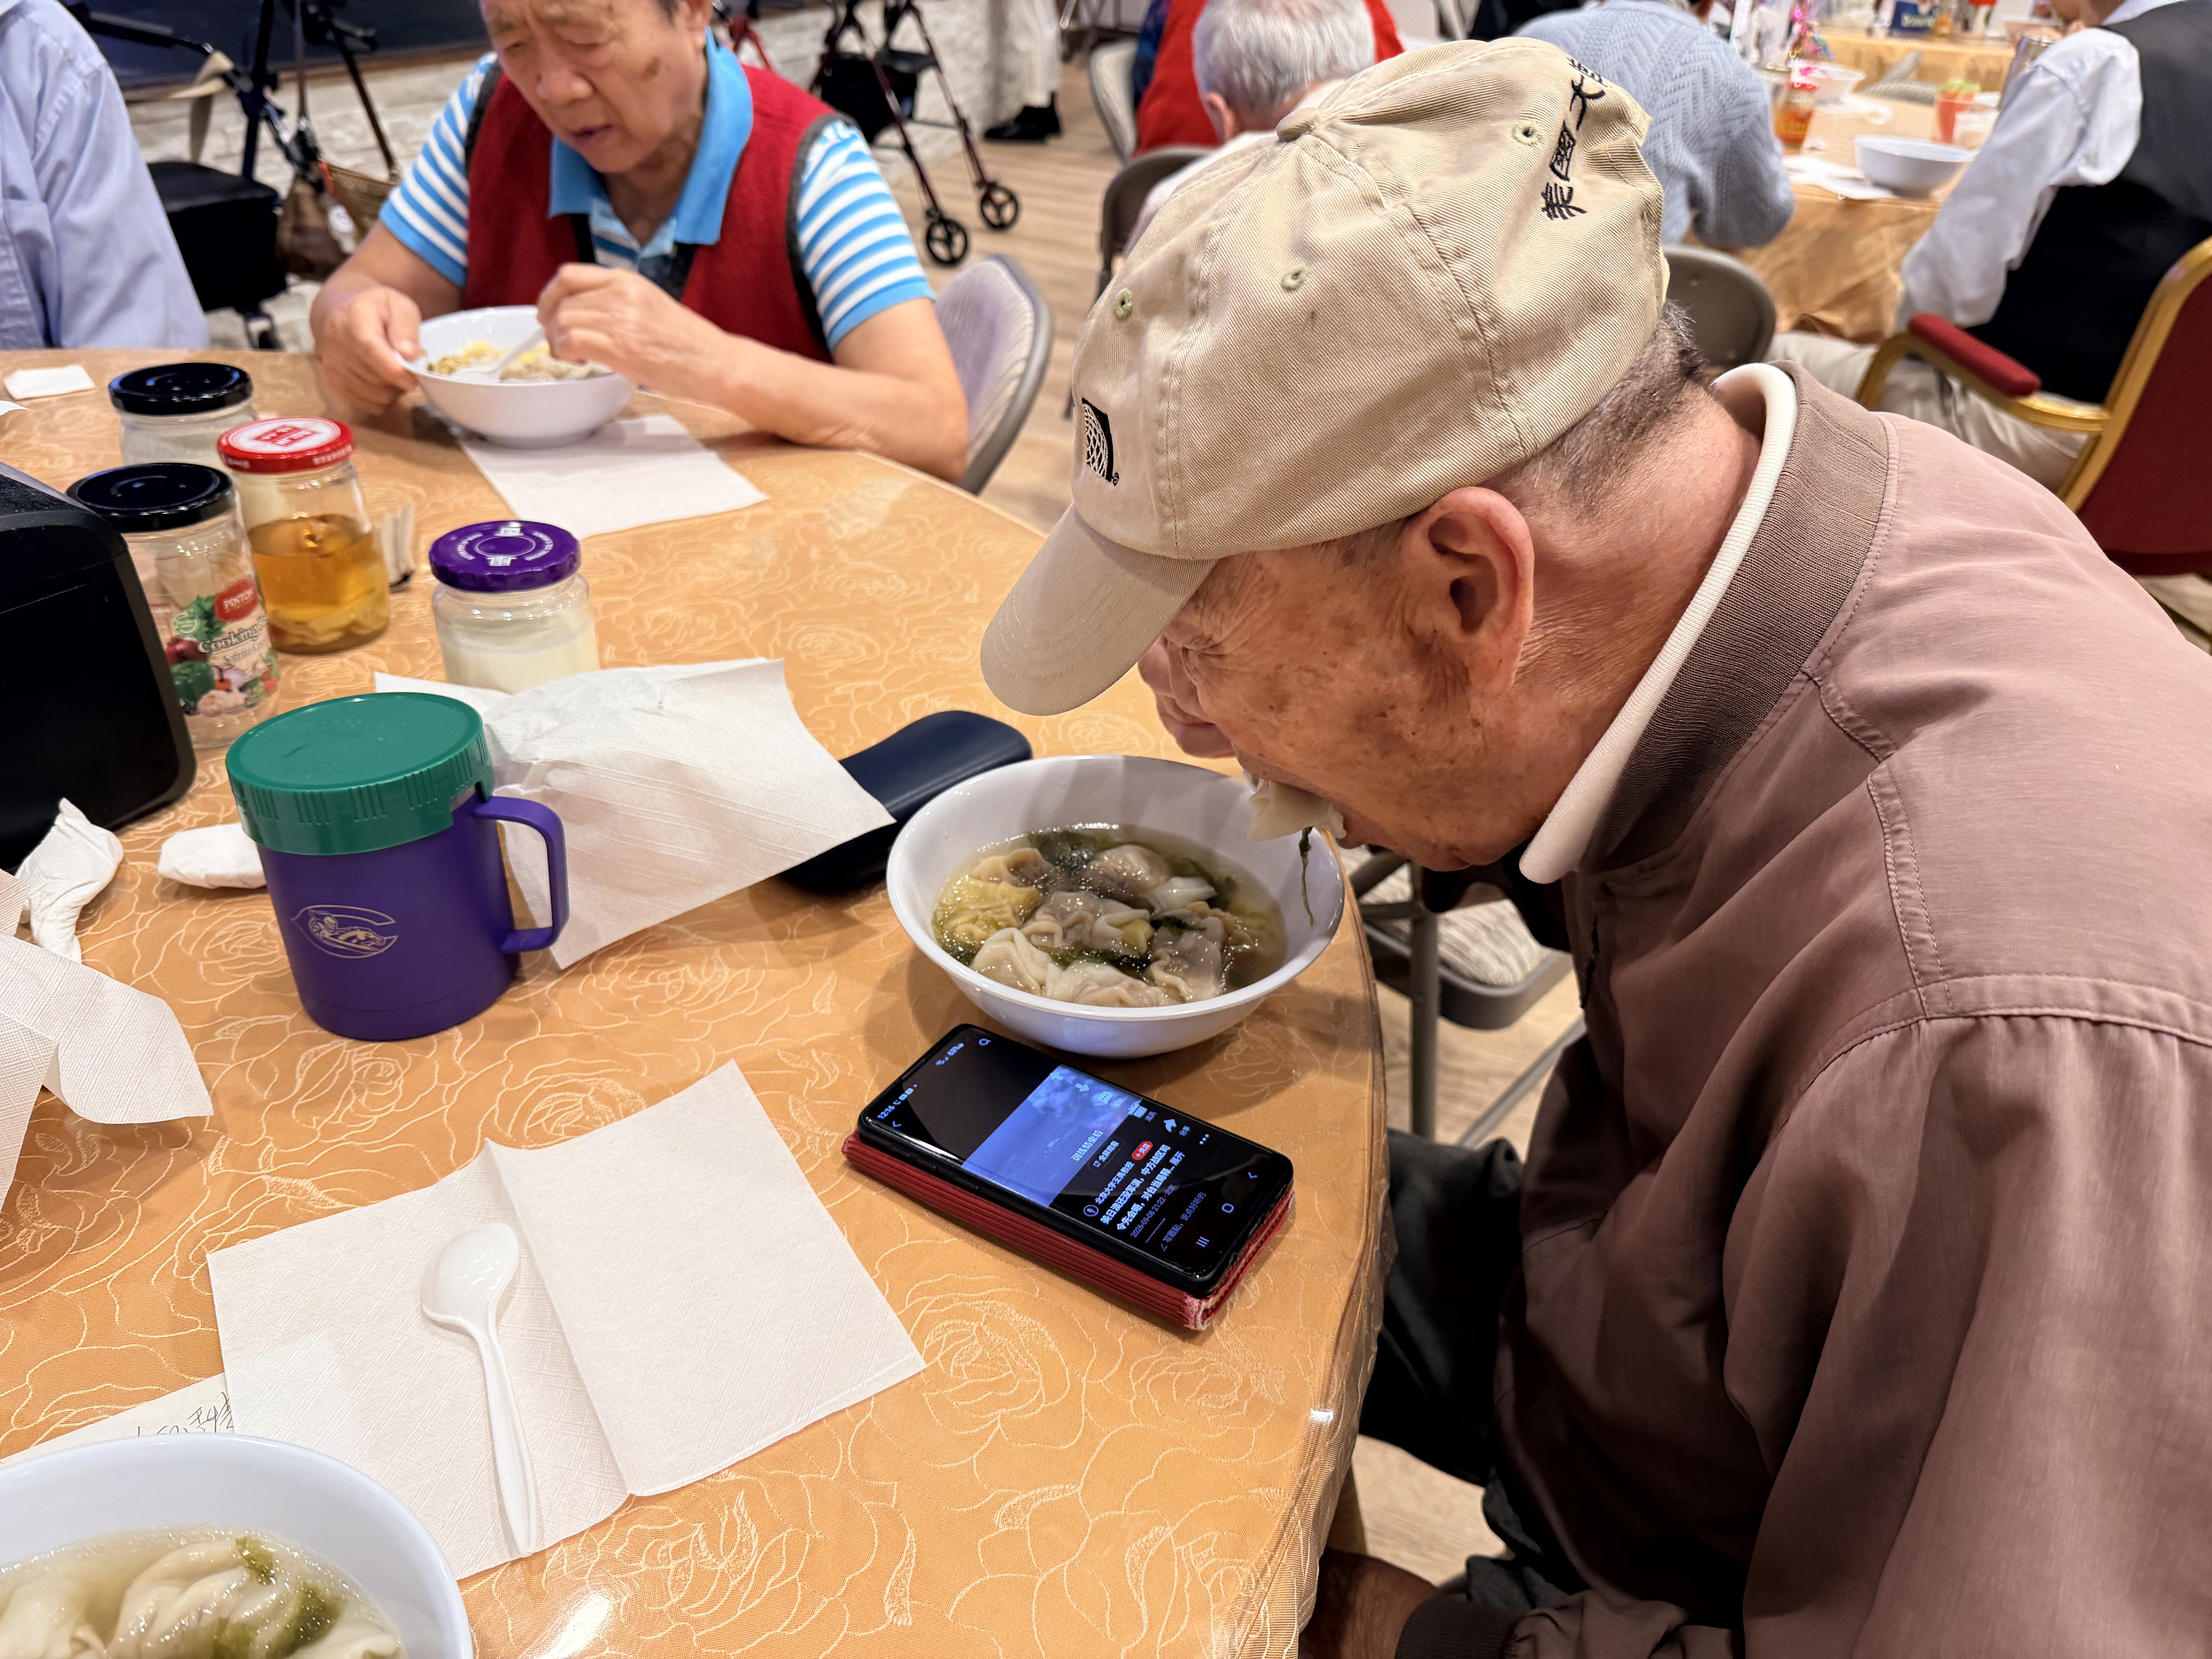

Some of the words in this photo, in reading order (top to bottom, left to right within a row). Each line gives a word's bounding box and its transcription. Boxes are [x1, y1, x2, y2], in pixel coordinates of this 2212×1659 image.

[1071, 1130, 1103, 1161] 训练结束后
